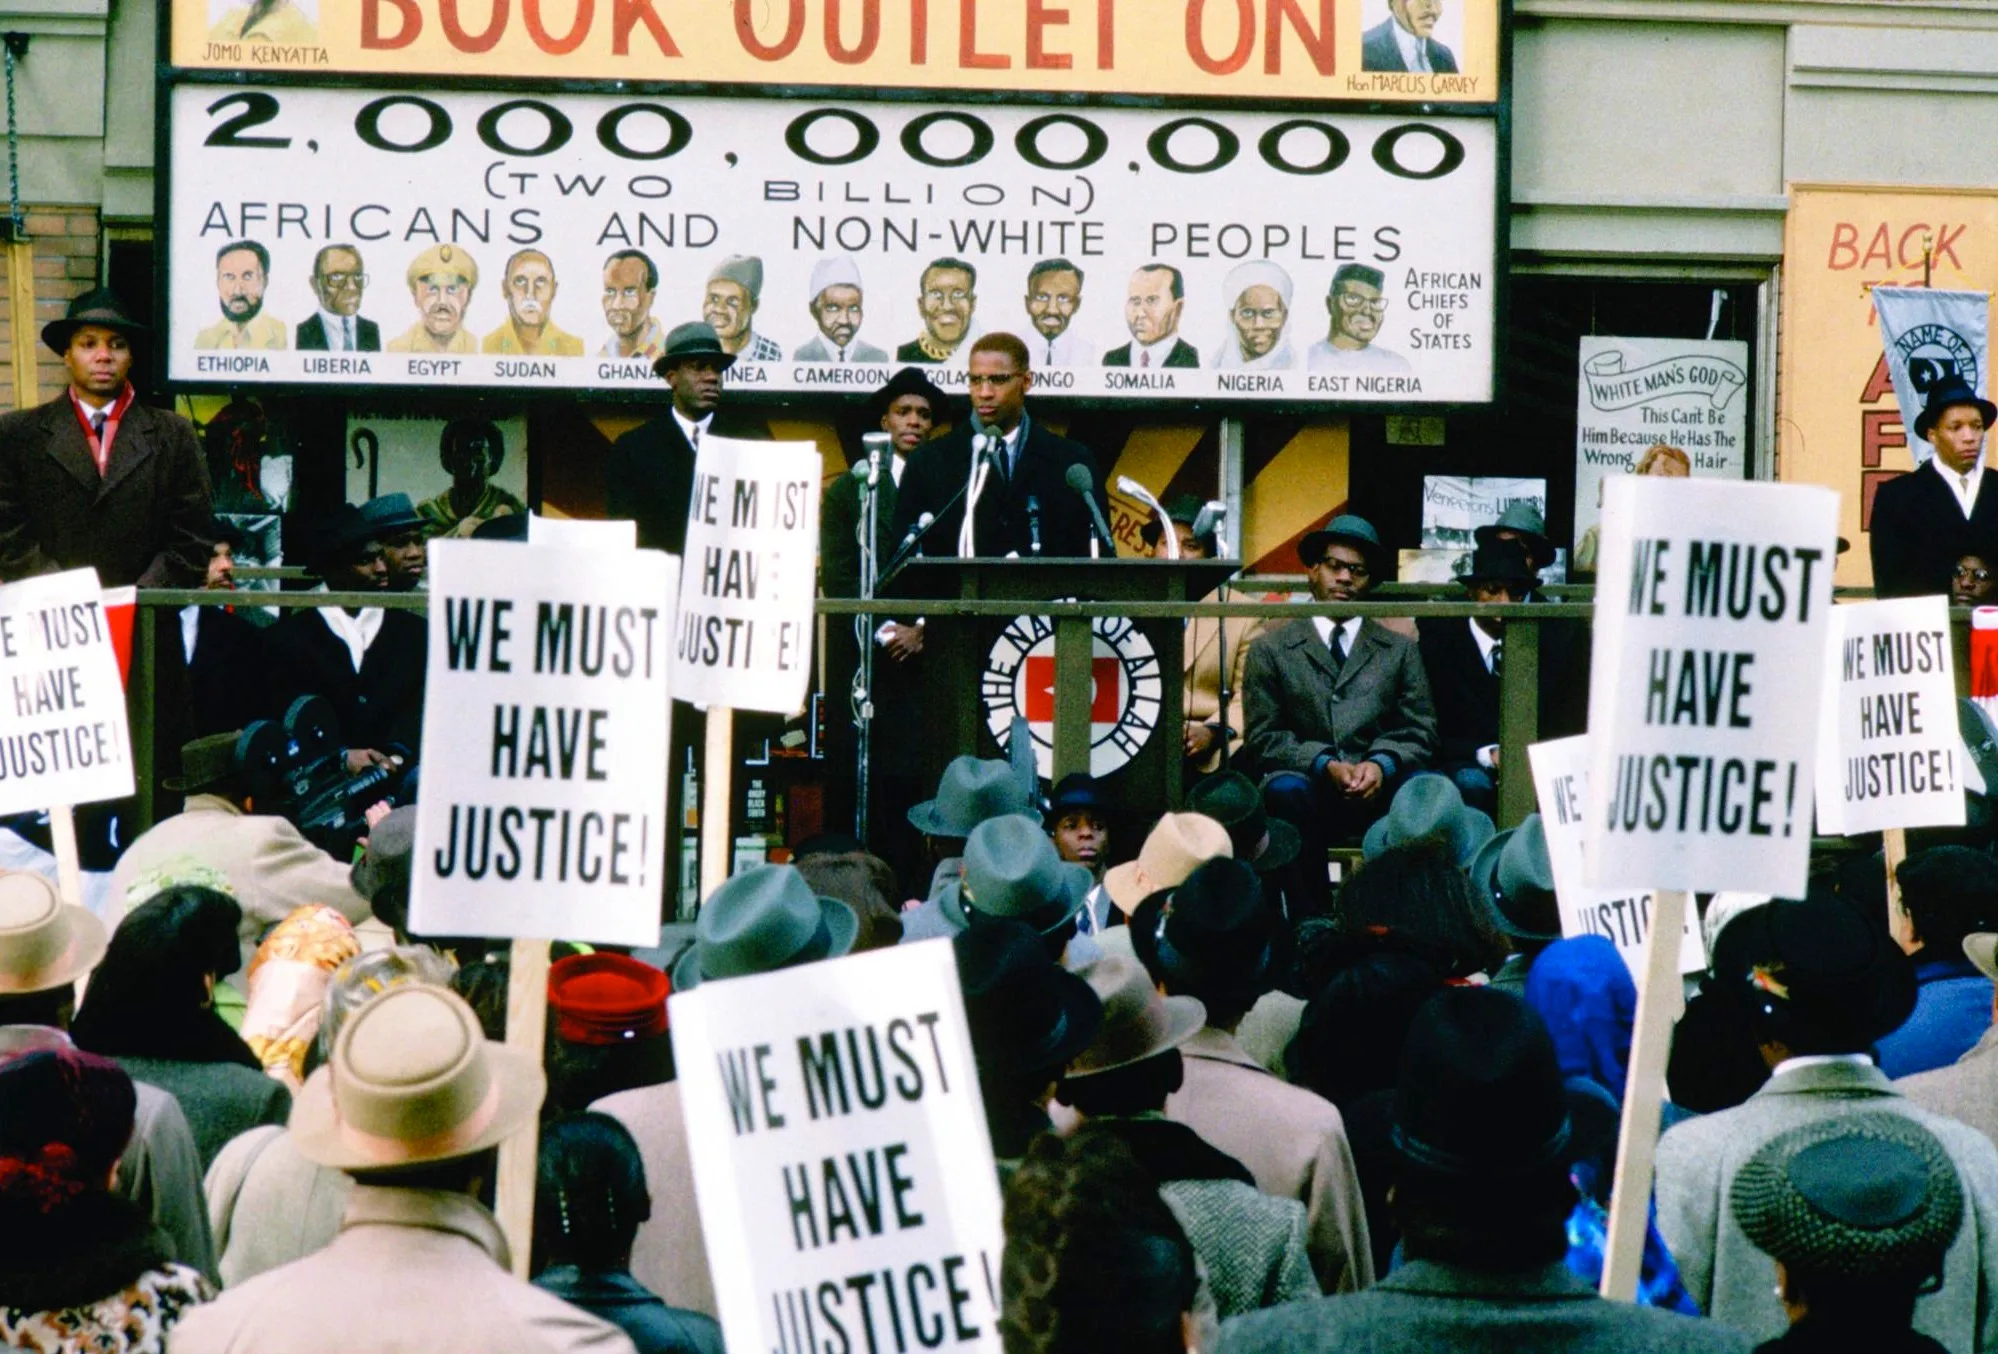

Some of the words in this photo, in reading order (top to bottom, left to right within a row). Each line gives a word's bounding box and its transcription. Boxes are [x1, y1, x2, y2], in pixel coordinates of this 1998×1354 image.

[1185, 0, 1336, 77] ON
[202, 41, 242, 62] JOMO
[251, 45, 330, 65] KENYATTA
[1371, 74, 1426, 94] MARCUS
[1430, 74, 1479, 95] GARVEY
[484, 161, 672, 199] (TWO
[763, 174, 1095, 216] BILLION)
[200, 201, 543, 245] AFRICANS
[597, 211, 719, 248] AND
[792, 214, 1105, 257] NON-WHITE
[1151, 222, 1402, 262] PEOPLES
[1828, 222, 1967, 271] BACK
[1405, 268, 1481, 289] AFRICAN
[1407, 290, 1469, 311] CHIEFS
[1433, 313, 1453, 329] OF
[1410, 327, 1472, 350] STATES
[198, 356, 269, 372] ETHIOPIA
[304, 358, 371, 374] LIBERIA
[408, 360, 461, 375] EGYPT
[495, 361, 555, 378] SUDAN
[724, 366, 767, 382] INEA
[793, 368, 889, 385] CAMEROON
[1031, 371, 1074, 388] ONGO
[1105, 372, 1175, 389] SOMALIA
[1218, 375, 1283, 391] NIGERIA
[1308, 376, 1350, 392] EAST
[1356, 376, 1422, 393] NIGERIA
[1593, 379, 1643, 402] WHITE
[1689, 365, 1718, 386] GOD
[1640, 406, 1669, 424] This
[1708, 409, 1726, 425] Be
[1582, 427, 1608, 445] Him
[1610, 428, 1668, 446] Because
[1670, 430, 1686, 446] He
[1688, 430, 1711, 446] Has
[1713, 430, 1737, 448] The
[1584, 448, 1636, 473] Wrong
[1685, 540, 1822, 623] MUST
[445, 597, 513, 673] WE
[534, 602, 657, 677] MUST
[1844, 637, 1865, 681] WE
[1873, 631, 1943, 676] MUST
[13, 667, 85, 717] HAVE
[1646, 649, 1754, 728] HAVE
[1861, 692, 1922, 739] HAVE
[491, 704, 607, 780] HAVE
[1846, 750, 1953, 801] JUSTICE!
[1555, 775, 1582, 824] WE
[1609, 754, 1797, 837] JUSTICE!
[434, 804, 646, 884] JUSTICE!
[720, 1044, 786, 1136] WE
[796, 1012, 948, 1120] MUST
[783, 1143, 924, 1251] HAVE
